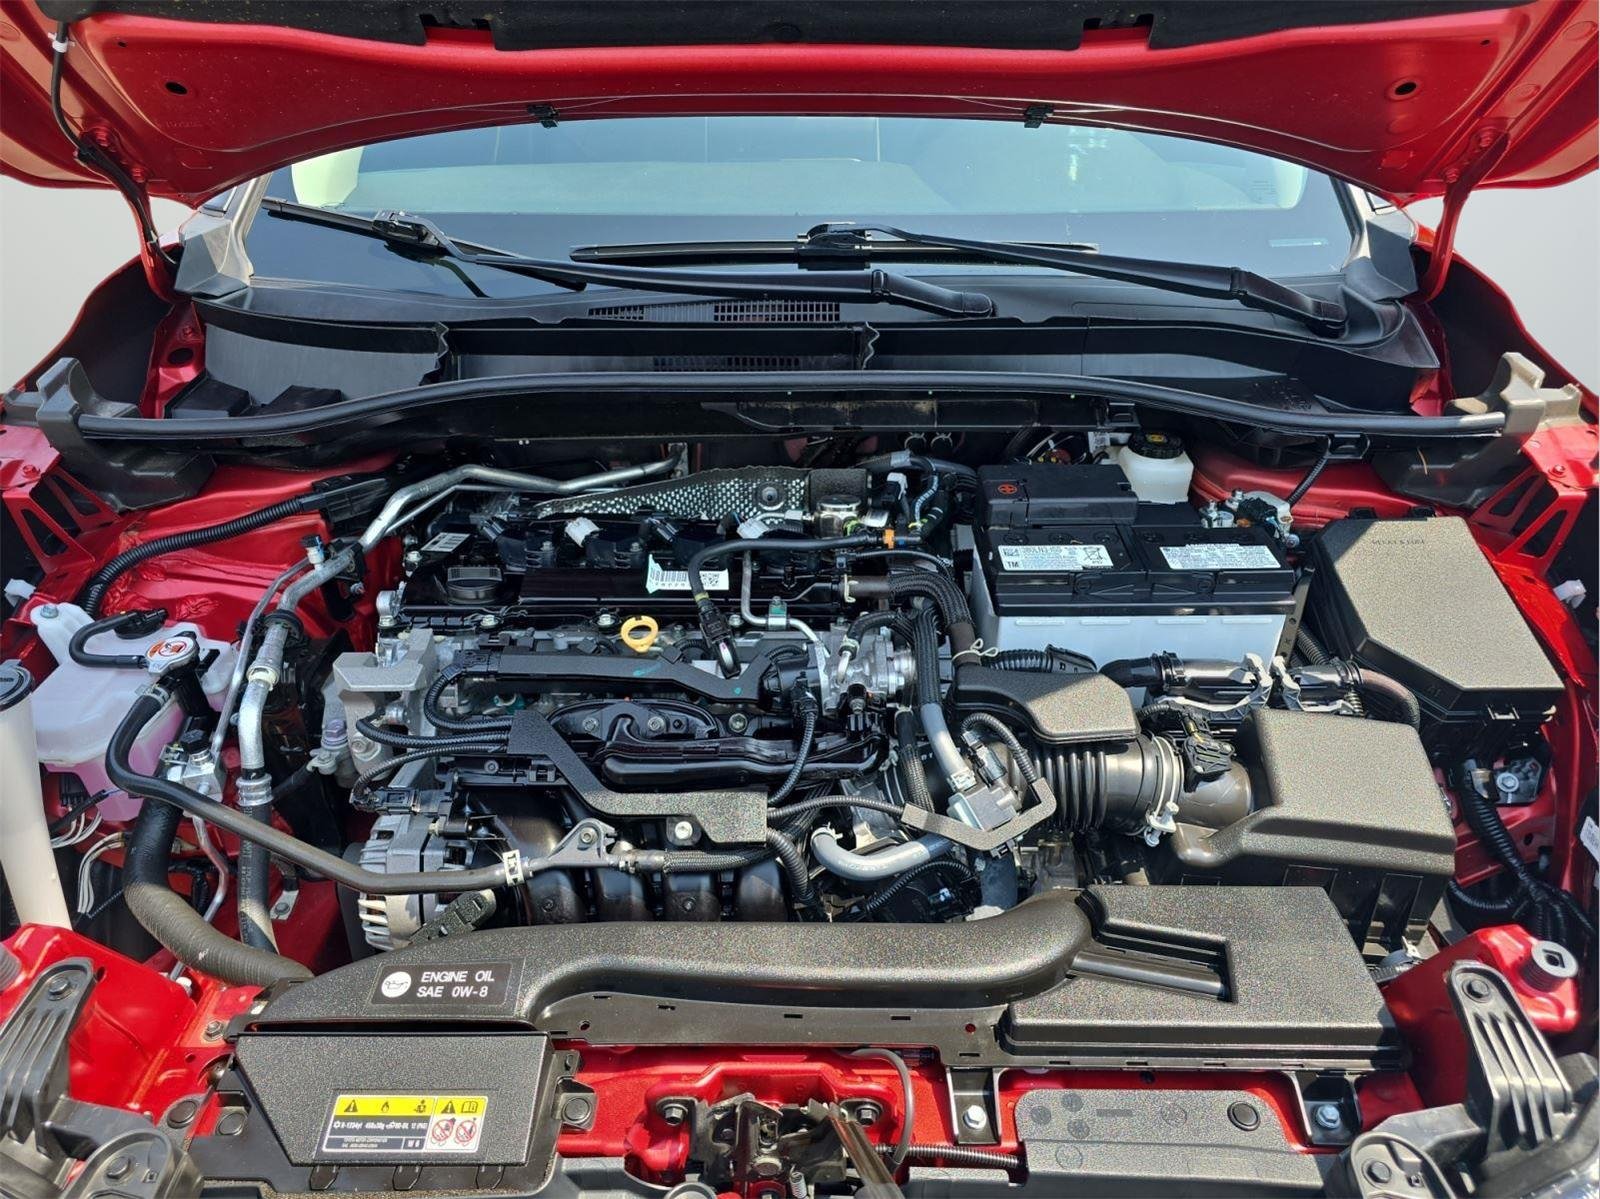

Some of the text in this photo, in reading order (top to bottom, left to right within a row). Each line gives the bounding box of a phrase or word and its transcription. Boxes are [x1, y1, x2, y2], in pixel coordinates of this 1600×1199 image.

[420, 970, 496, 983] ENGINE OIL
[416, 986, 489, 998] SAE 0W-8
